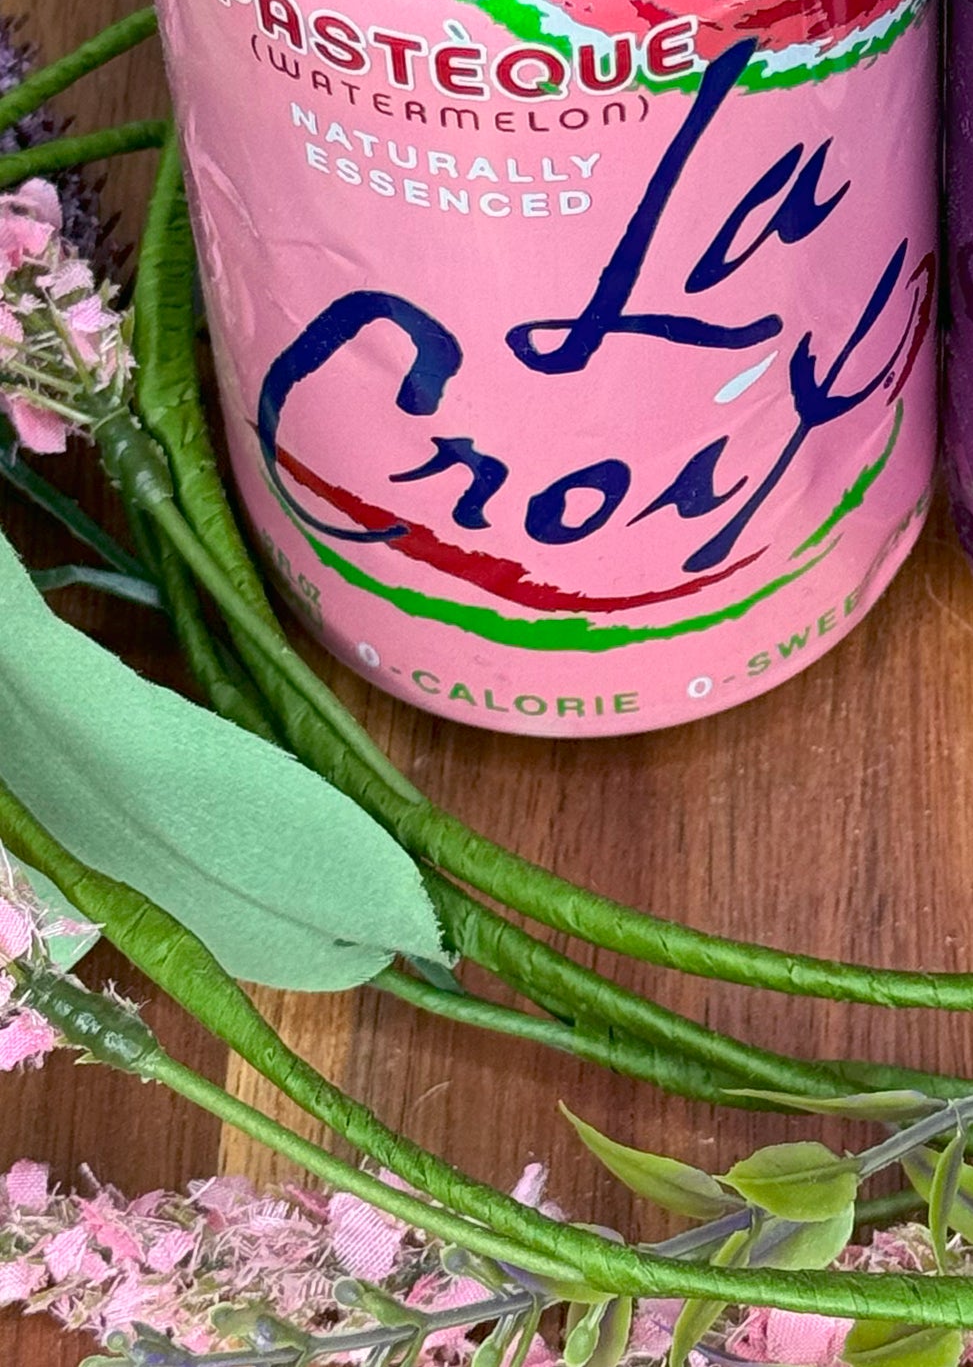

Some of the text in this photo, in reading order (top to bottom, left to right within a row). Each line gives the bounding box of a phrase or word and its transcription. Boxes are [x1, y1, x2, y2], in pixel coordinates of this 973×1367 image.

[251, 42, 649, 132] (WATERMELON)
[291, 102, 600, 182] NATURALLY
[306, 142, 592, 218] ESSENCED
[505, 36, 851, 374] La
[258, 237, 919, 572] Croix
